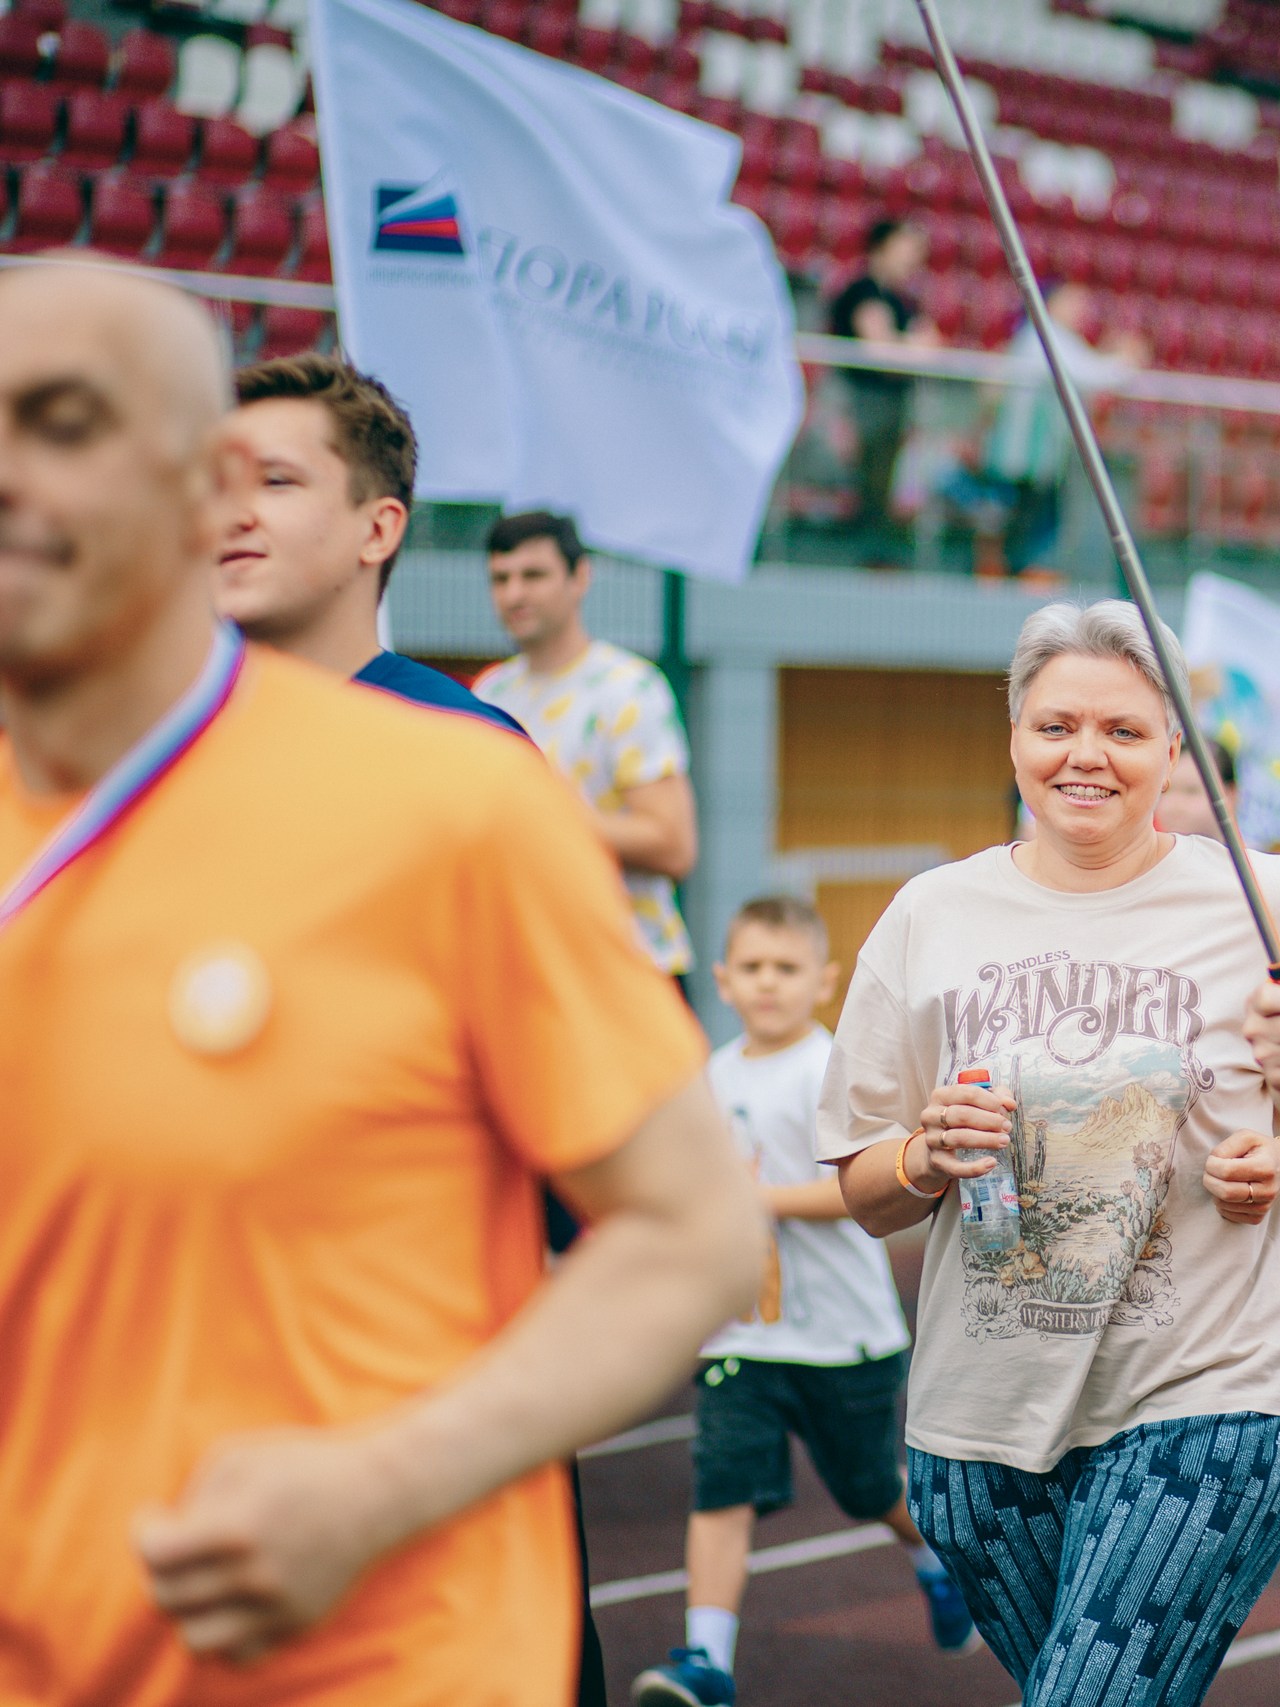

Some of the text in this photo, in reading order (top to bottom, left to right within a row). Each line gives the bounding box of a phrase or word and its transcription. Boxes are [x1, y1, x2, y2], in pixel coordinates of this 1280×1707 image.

[1007, 950, 1071, 974] ENDLESS
[942, 959, 1216, 1092] WANDER
[1022, 1307, 1087, 1329] WESTERN
